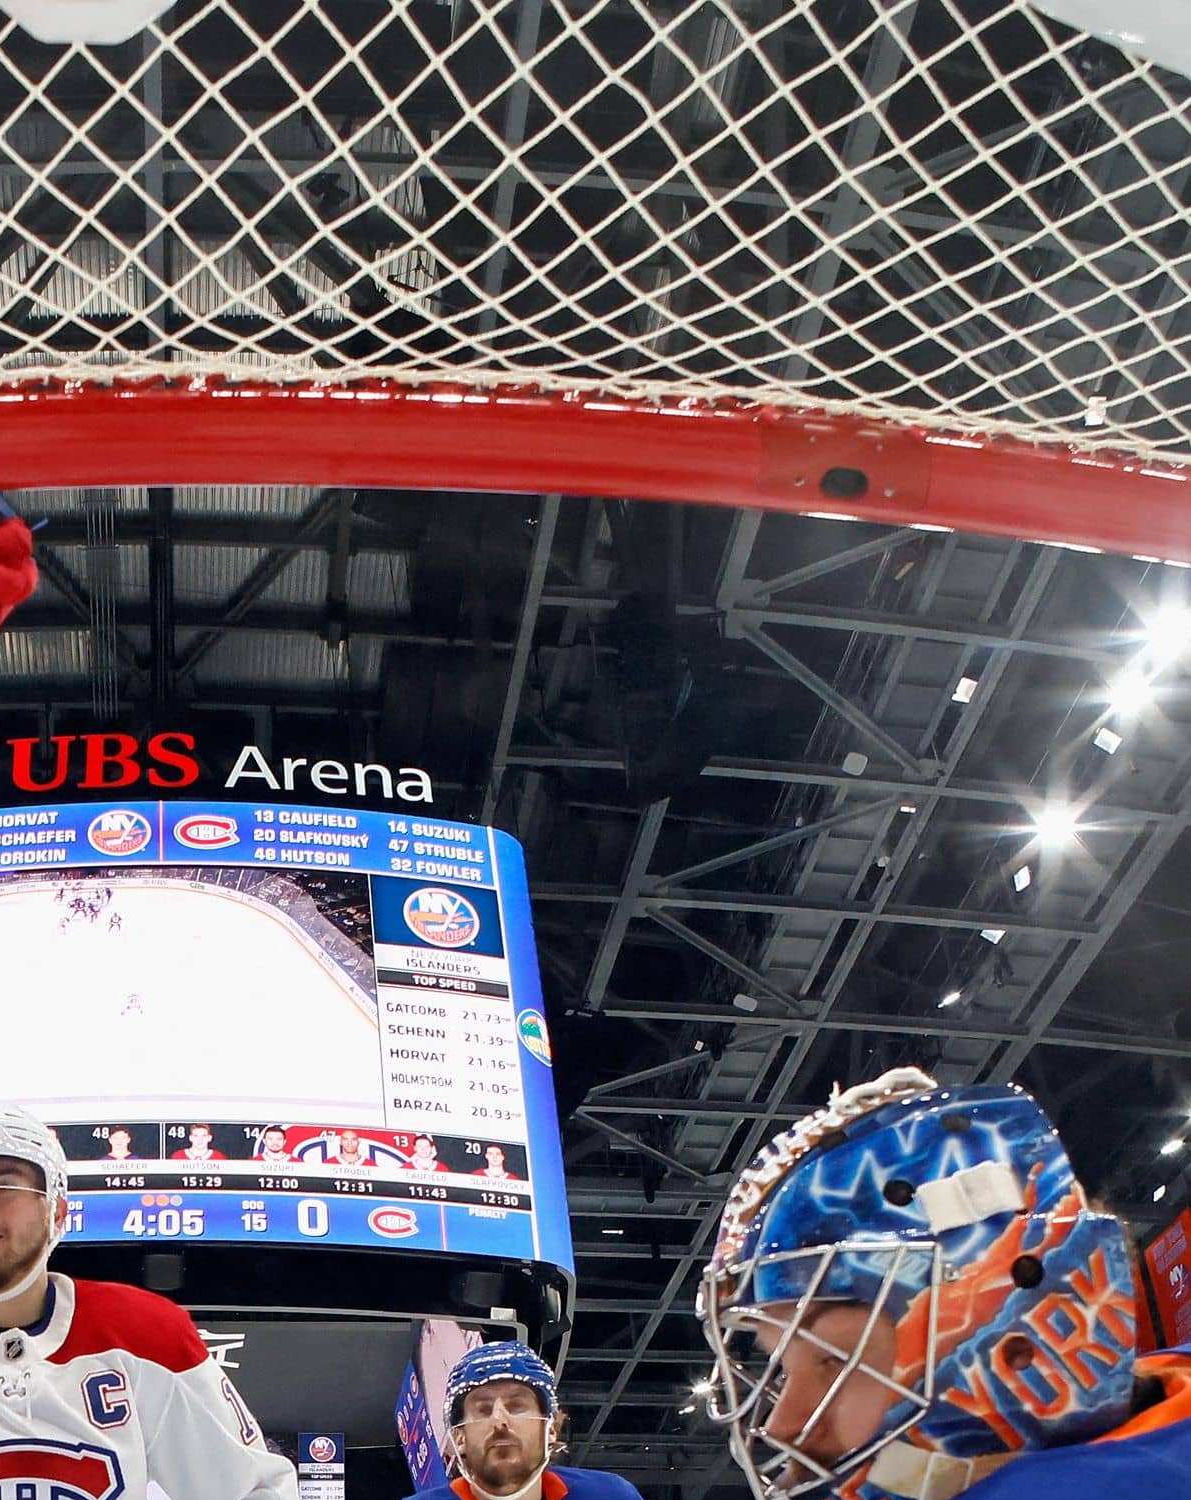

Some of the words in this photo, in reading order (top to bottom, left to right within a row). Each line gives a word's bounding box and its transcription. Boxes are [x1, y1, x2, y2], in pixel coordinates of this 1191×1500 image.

[6, 732, 200, 792] UBS
[224, 744, 434, 803] Arena
[254, 810, 274, 823] 13
[278, 811, 357, 829] CAUFIELD
[253, 829, 275, 842] 20
[279, 831, 369, 849] SLAFKOVSKÝ
[388, 820, 408, 834] 14
[411, 823, 471, 844] SUZUKI
[254, 848, 277, 861] 48
[280, 850, 350, 867] HUTSON
[388, 838, 410, 853] 47
[414, 843, 485, 864] STRUBLE
[391, 859, 412, 873] 32
[415, 861, 482, 882] FOWLER
[418, 892, 460, 914] NY
[406, 958, 480, 976] ISLANDERS
[412, 975, 437, 987] TOP
[438, 977, 477, 992] SPEED
[386, 1002, 446, 1018] GATCOMB
[388, 1024, 446, 1039] SCHENN
[390, 1048, 447, 1063] HORVAT
[391, 1072, 453, 1088] HOLMSTROM
[393, 1098, 452, 1114] BARZAL
[92, 1127, 110, 1140] 48
[168, 1126, 187, 1139] 48
[243, 1127, 259, 1140] 14
[393, 1136, 409, 1148] 13
[464, 1142, 481, 1155] 20
[104, 1176, 145, 1188] 14:45
[182, 1176, 223, 1188] 15:29
[258, 1178, 299, 1190] 12:00
[334, 1181, 374, 1193] 12:31
[409, 1186, 448, 1199] 11:43
[481, 1192, 519, 1207] 12:30
[67, 1200, 84, 1211] OG
[65, 1213, 83, 1232] 11
[122, 1208, 206, 1237] 4:05
[241, 1213, 268, 1232] 15
[297, 1199, 330, 1237] 0
[946, 1248, 1136, 1450] YORK
[81, 1369, 131, 1430] C
